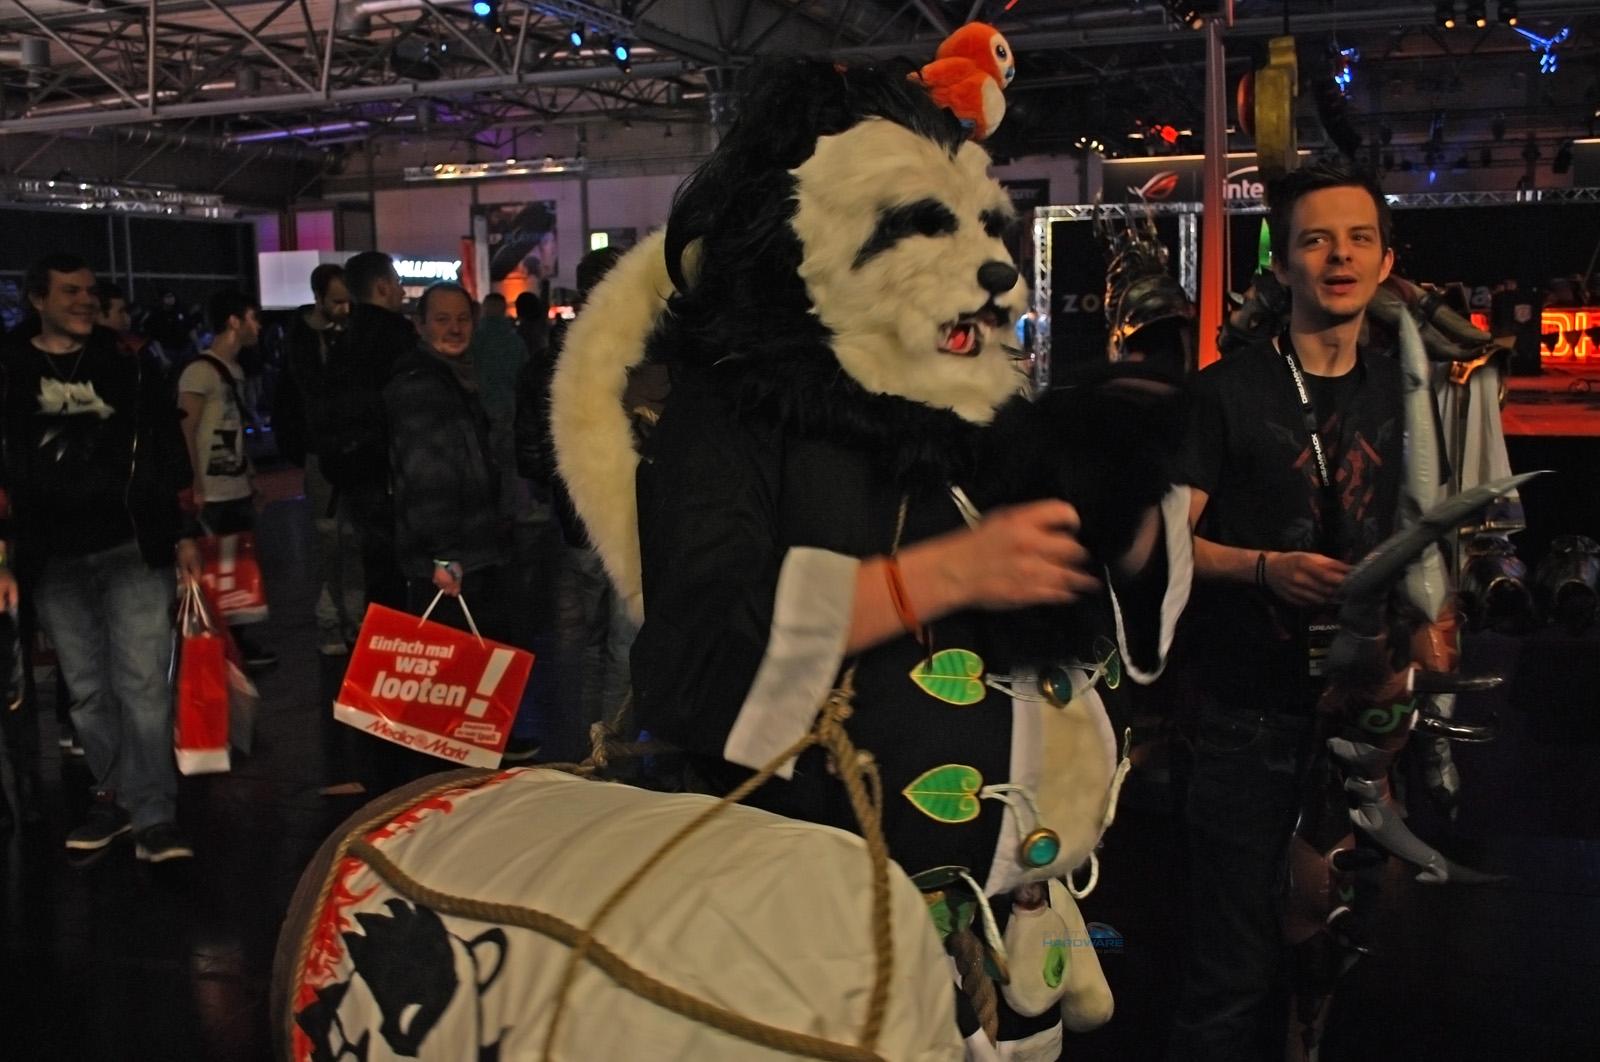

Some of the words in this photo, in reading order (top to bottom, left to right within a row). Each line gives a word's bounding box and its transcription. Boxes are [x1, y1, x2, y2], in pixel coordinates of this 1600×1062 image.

[1222, 179, 1264, 199] inte
[369, 636, 424, 656] Einfach
[425, 643, 455, 659] mal
[395, 656, 440, 676] was
